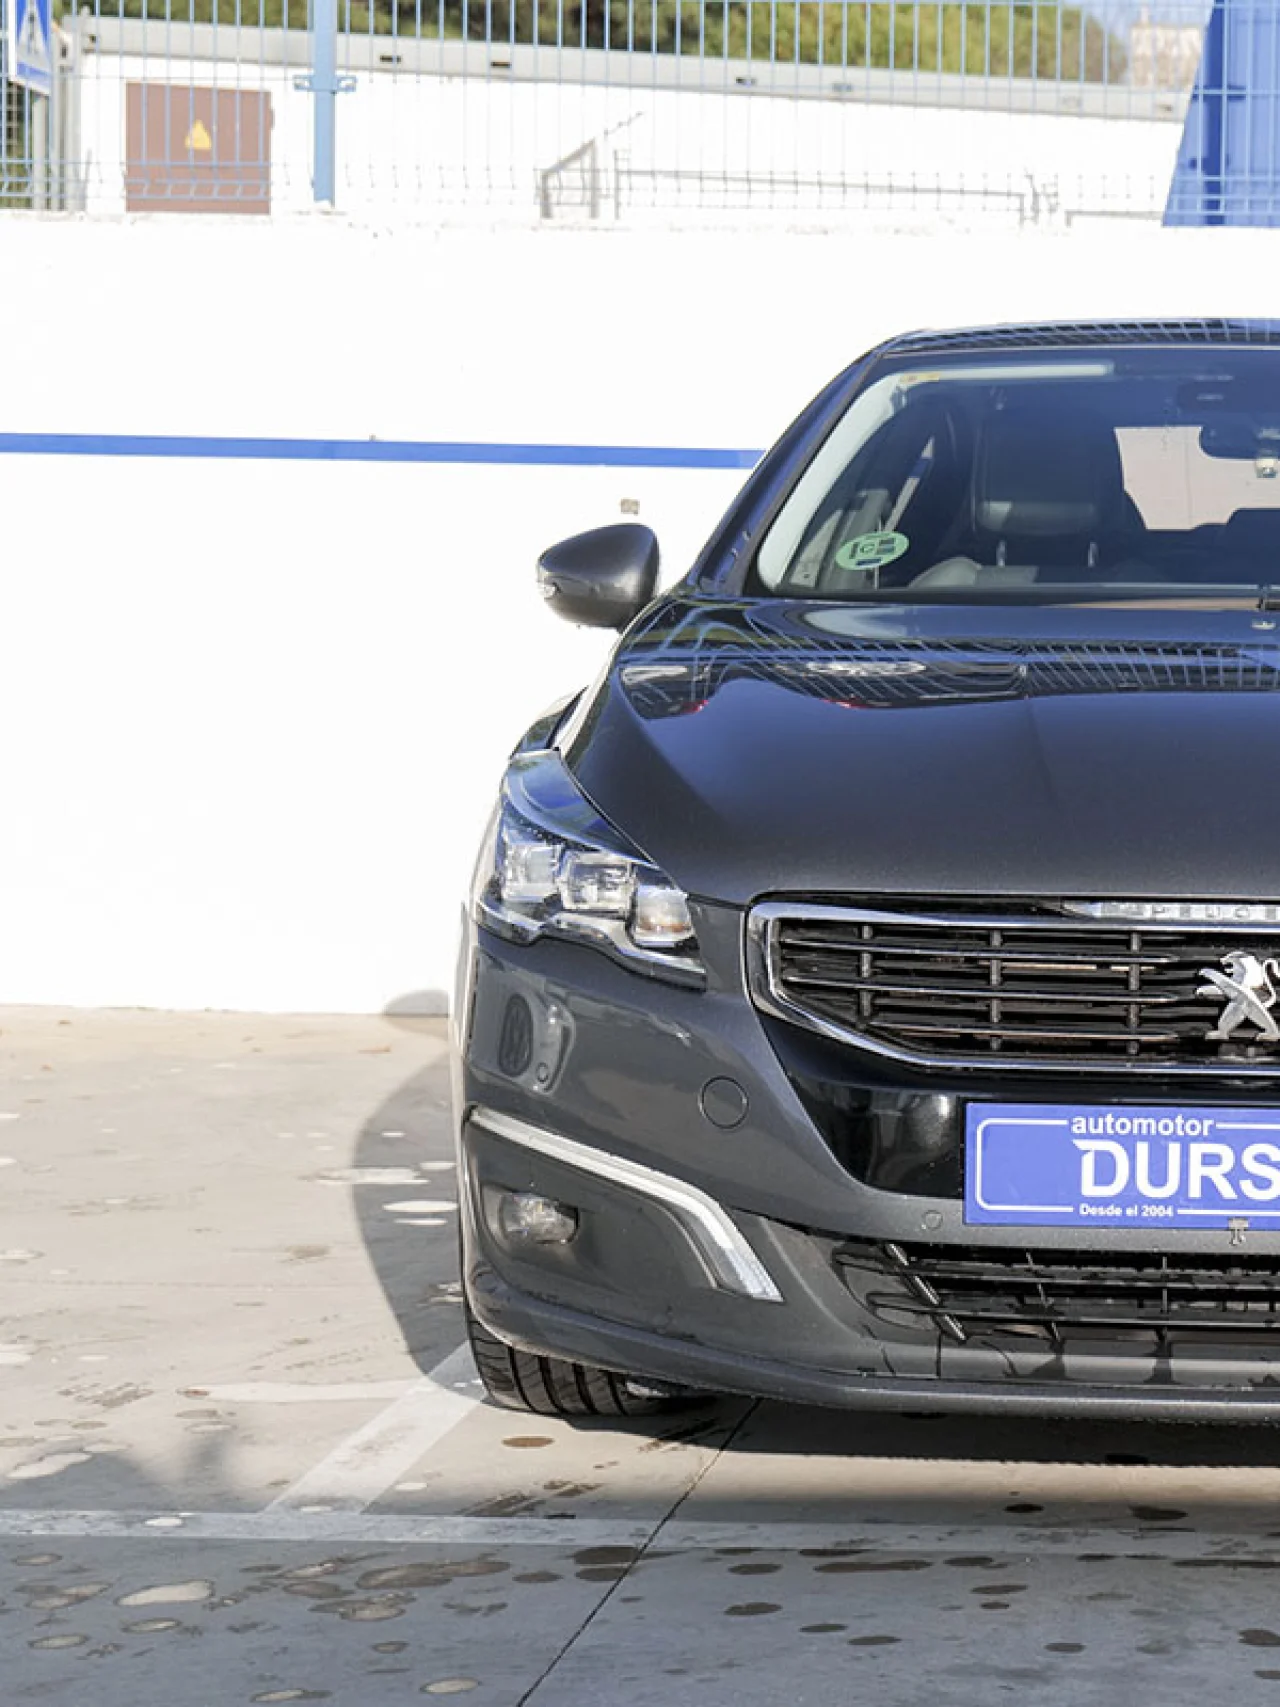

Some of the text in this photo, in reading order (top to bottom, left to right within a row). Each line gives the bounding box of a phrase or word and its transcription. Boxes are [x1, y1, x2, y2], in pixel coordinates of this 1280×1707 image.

[1071, 1113, 1214, 1136] automotor
[1079, 1203, 1174, 1217] Desde el 2004
